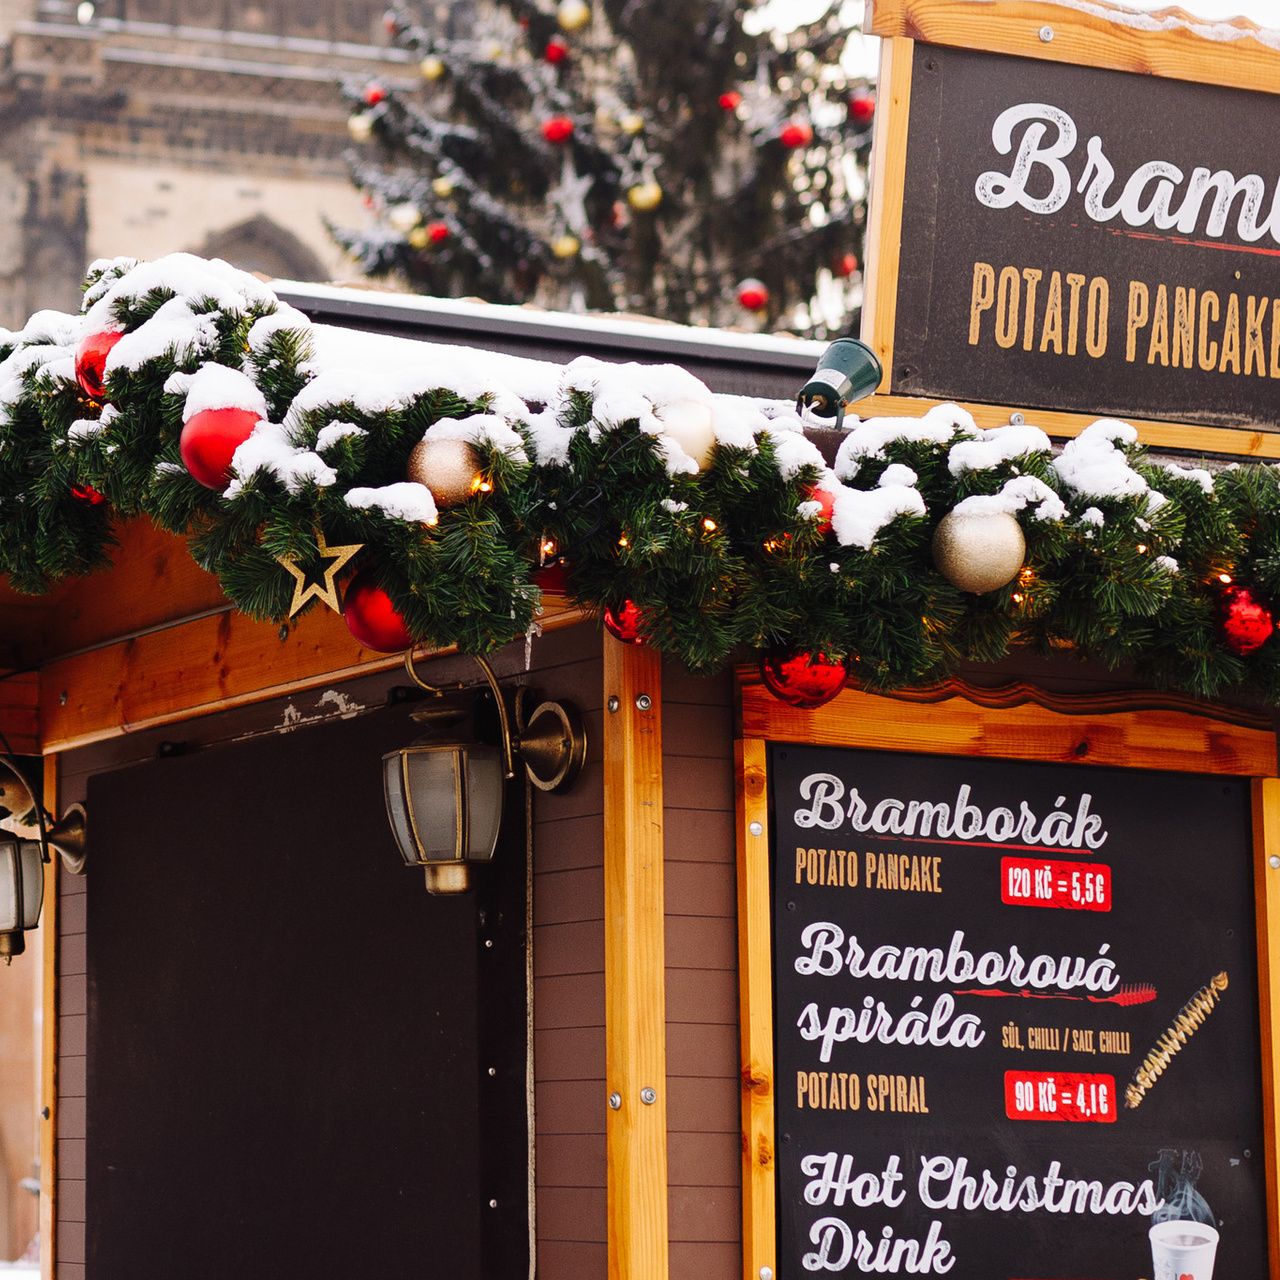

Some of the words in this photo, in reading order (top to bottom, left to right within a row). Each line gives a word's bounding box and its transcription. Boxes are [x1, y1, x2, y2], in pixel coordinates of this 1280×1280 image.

[975, 102, 1280, 244] Bram
[969, 262, 1109, 358] POTATO
[794, 772, 1108, 850] Bramborák
[796, 848, 858, 887] POTATO
[866, 853, 942, 892] PANCAKE
[1009, 868, 1030, 897] 120
[1035, 866, 1052, 899] KČ
[1058, 881, 1067, 892] =
[1072, 872, 1104, 905] 5,5€
[795, 922, 1120, 991] Bramborová
[797, 993, 985, 1062] spirála
[1028, 1028, 1059, 1050] CHILLI
[1072, 1030, 1095, 1054] SALT,
[1100, 1031, 1130, 1054] CHILLI
[797, 1071, 860, 1110] POTATO
[867, 1074, 929, 1113] SPIRAL
[1015, 1081, 1034, 1111] 90
[1038, 1078, 1056, 1112] KČ
[1062, 1093, 1072, 1104] =
[1076, 1083, 1108, 1116] 4,1€
[801, 1152, 906, 1207] Hot
[919, 1155, 1165, 1216] Christmas
[802, 1217, 956, 1274] Drink
